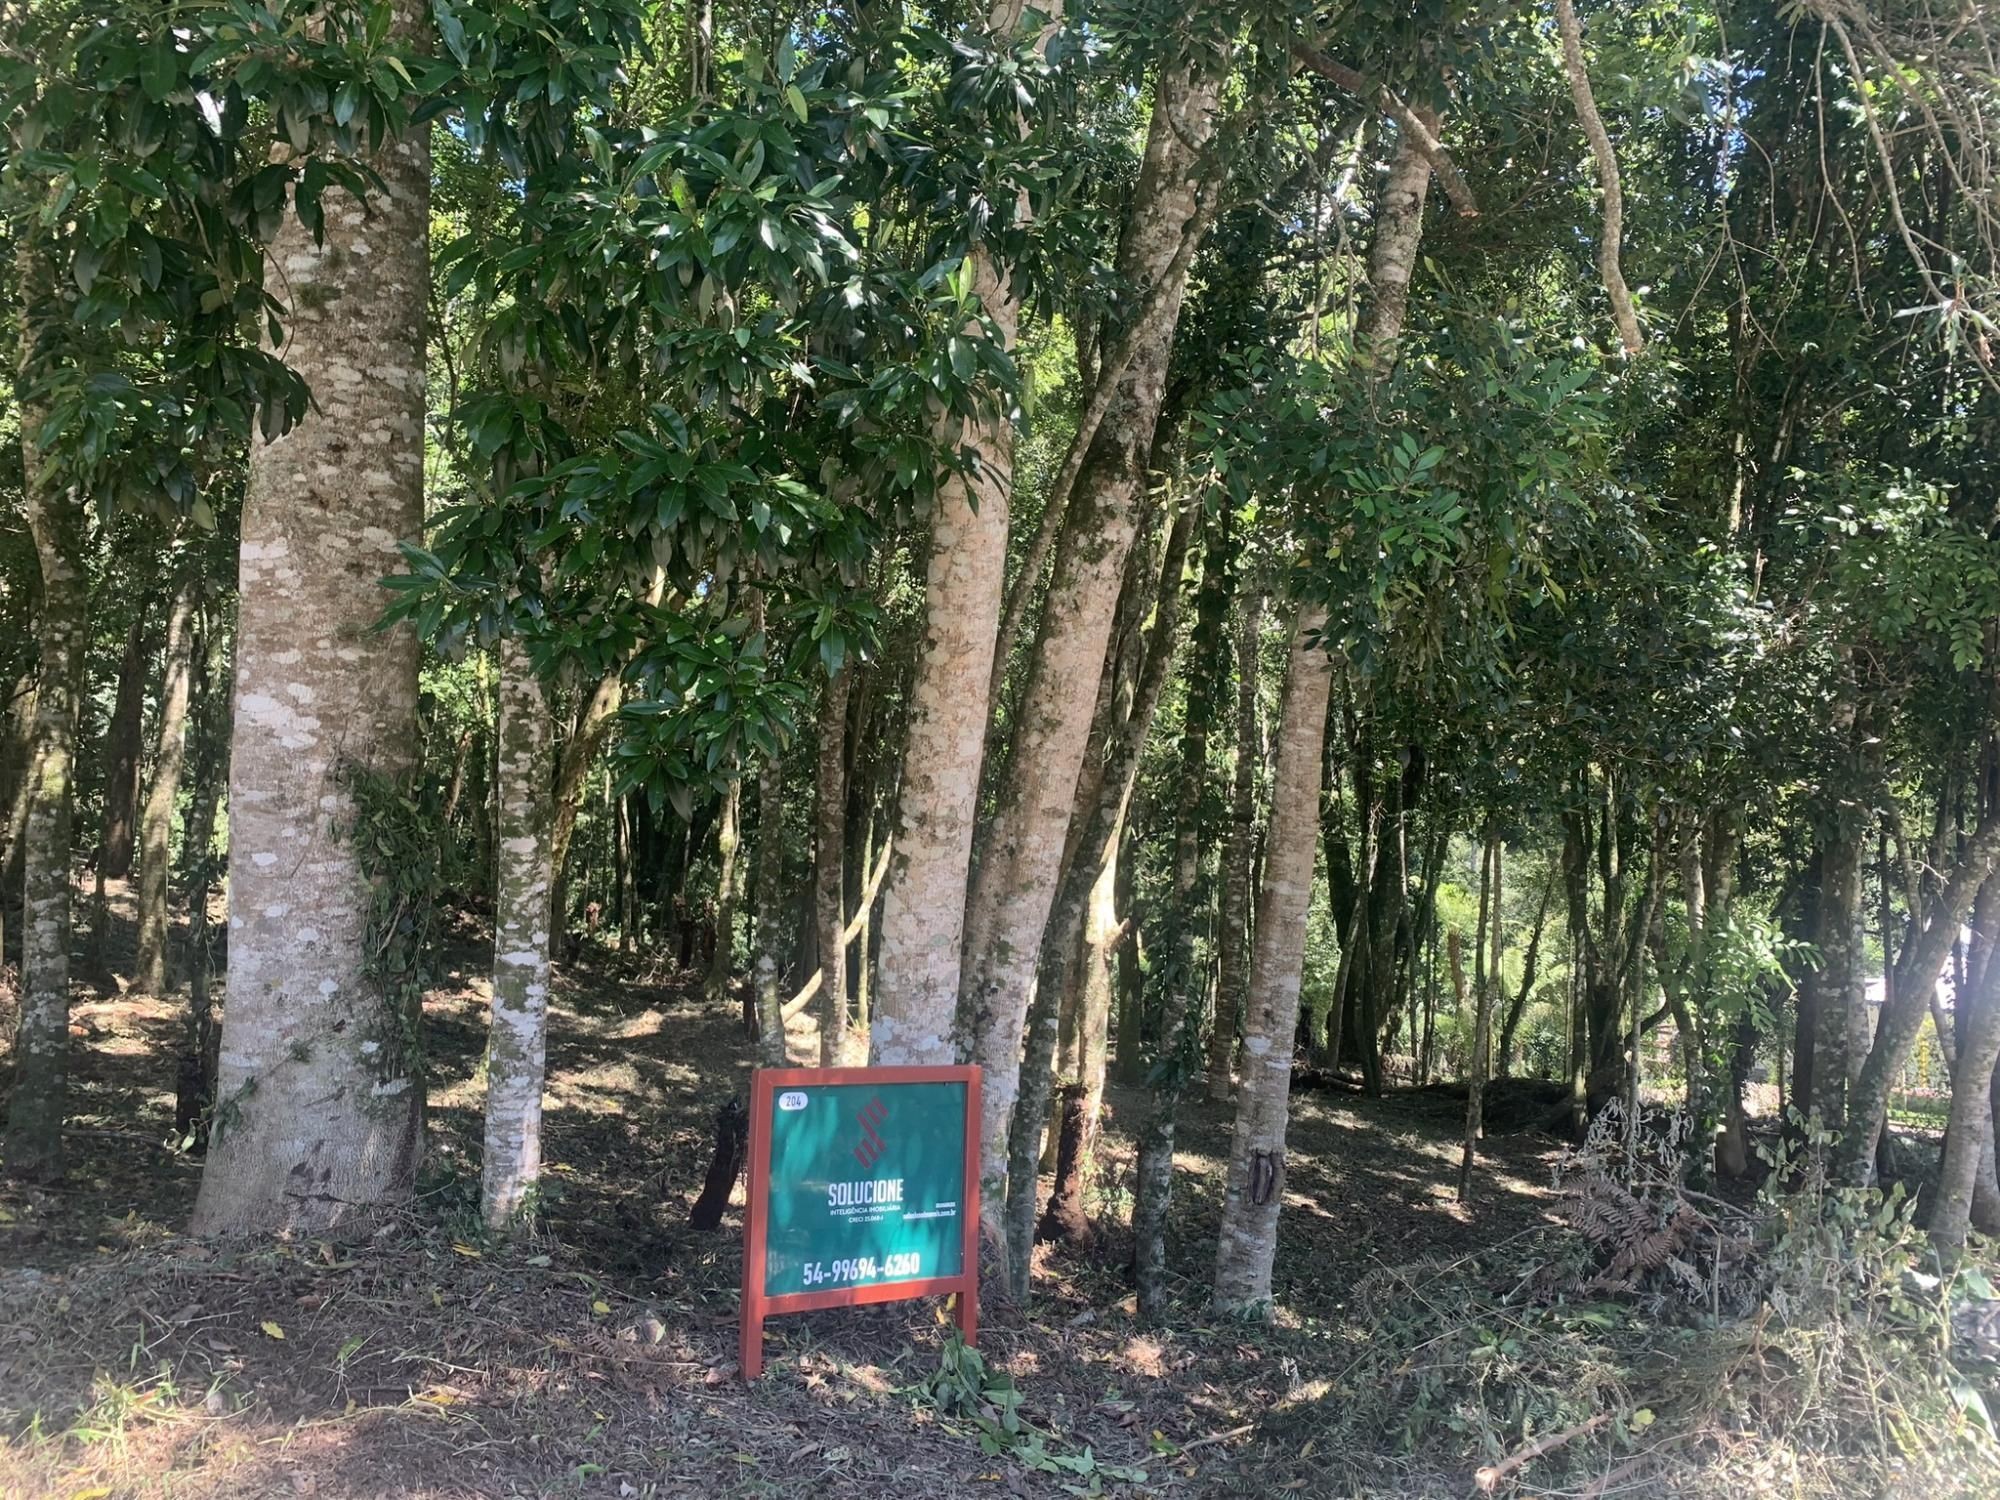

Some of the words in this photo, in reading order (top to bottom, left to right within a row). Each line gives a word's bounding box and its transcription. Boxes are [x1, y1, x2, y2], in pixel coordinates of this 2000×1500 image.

[785, 1095, 802, 1107] 204
[828, 1179, 904, 1206] SOLUCIONE
[829, 1206, 868, 1216] INTELIGÊNCIA
[868, 1203, 902, 1213] IMOBILIÁRIA
[802, 1252, 921, 1286] 54-99694-6260
